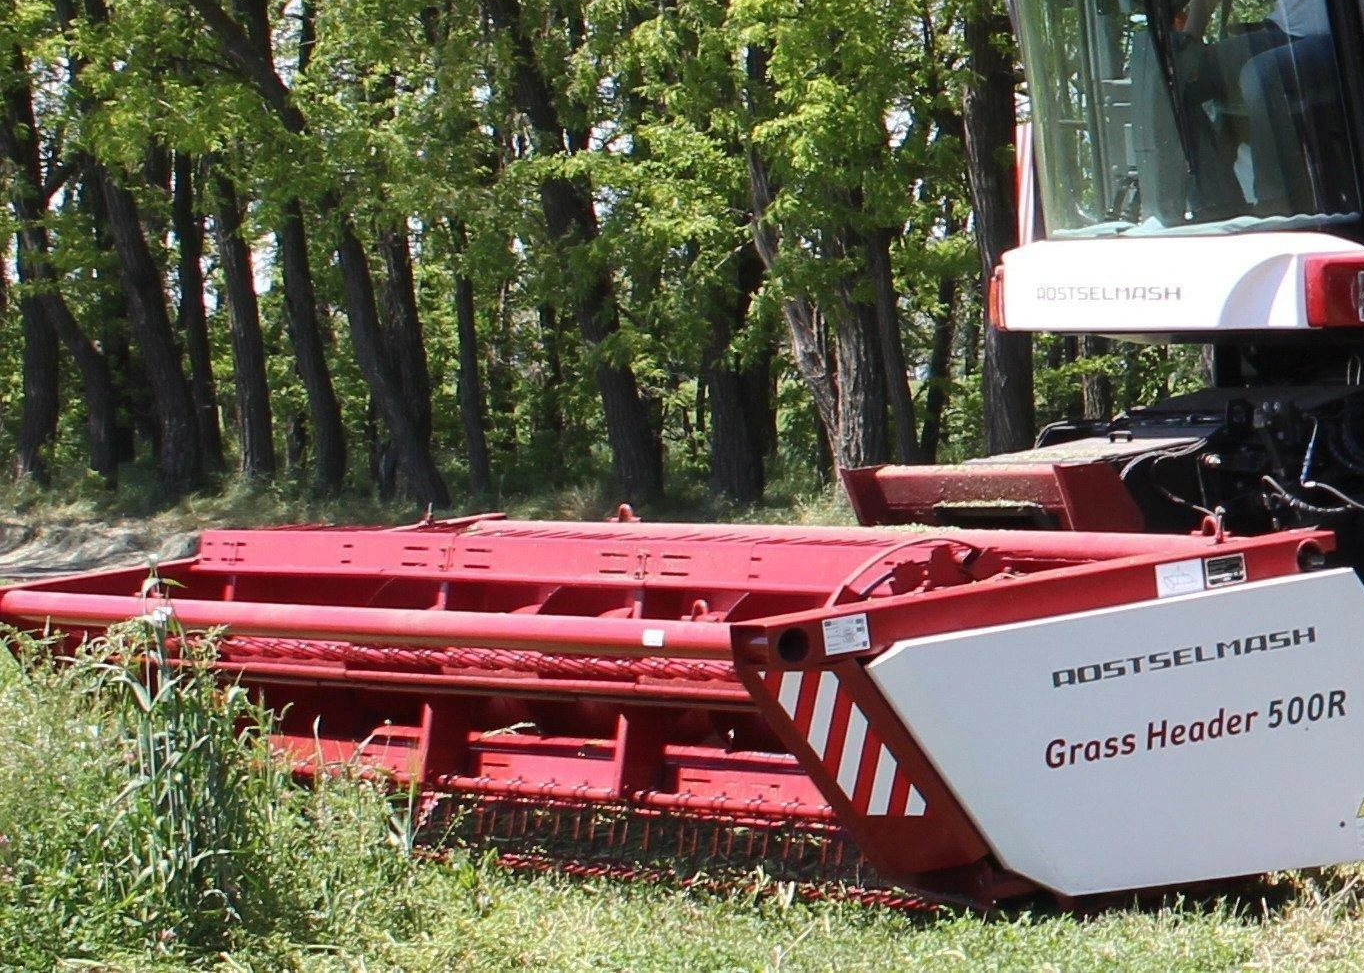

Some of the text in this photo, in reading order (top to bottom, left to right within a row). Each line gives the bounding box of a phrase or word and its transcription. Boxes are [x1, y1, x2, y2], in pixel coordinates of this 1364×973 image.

[1051, 626, 1316, 688] ROSTSELMASH
[1045, 689, 1347, 769] Grass Header 500R
